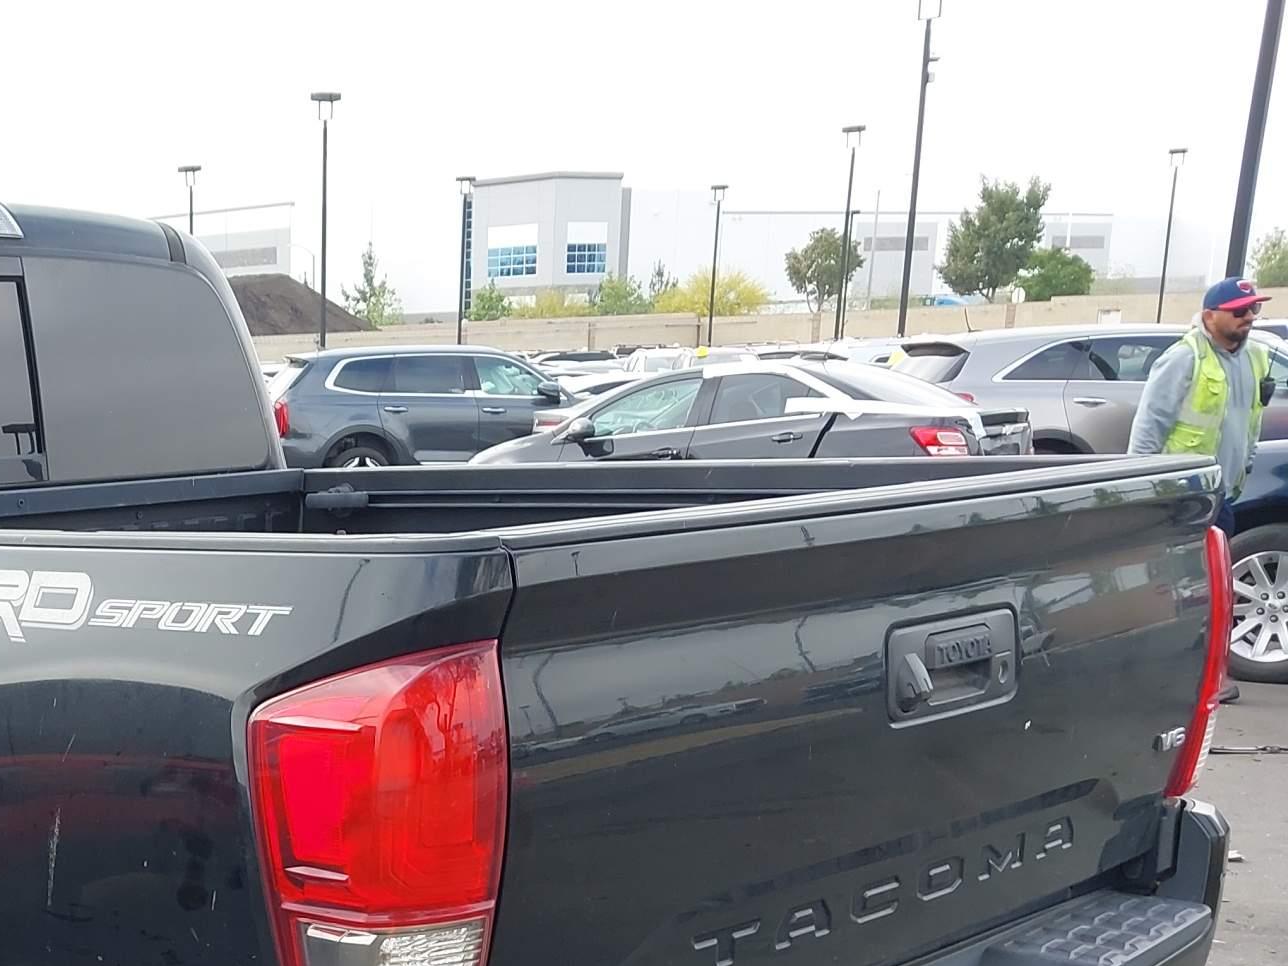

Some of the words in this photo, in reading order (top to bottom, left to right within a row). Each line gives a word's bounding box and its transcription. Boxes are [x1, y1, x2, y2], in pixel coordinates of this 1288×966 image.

[88, 599, 294, 636] SPORT
[937, 633, 992, 665] TOYOTA
[1159, 726, 1186, 752] V6
